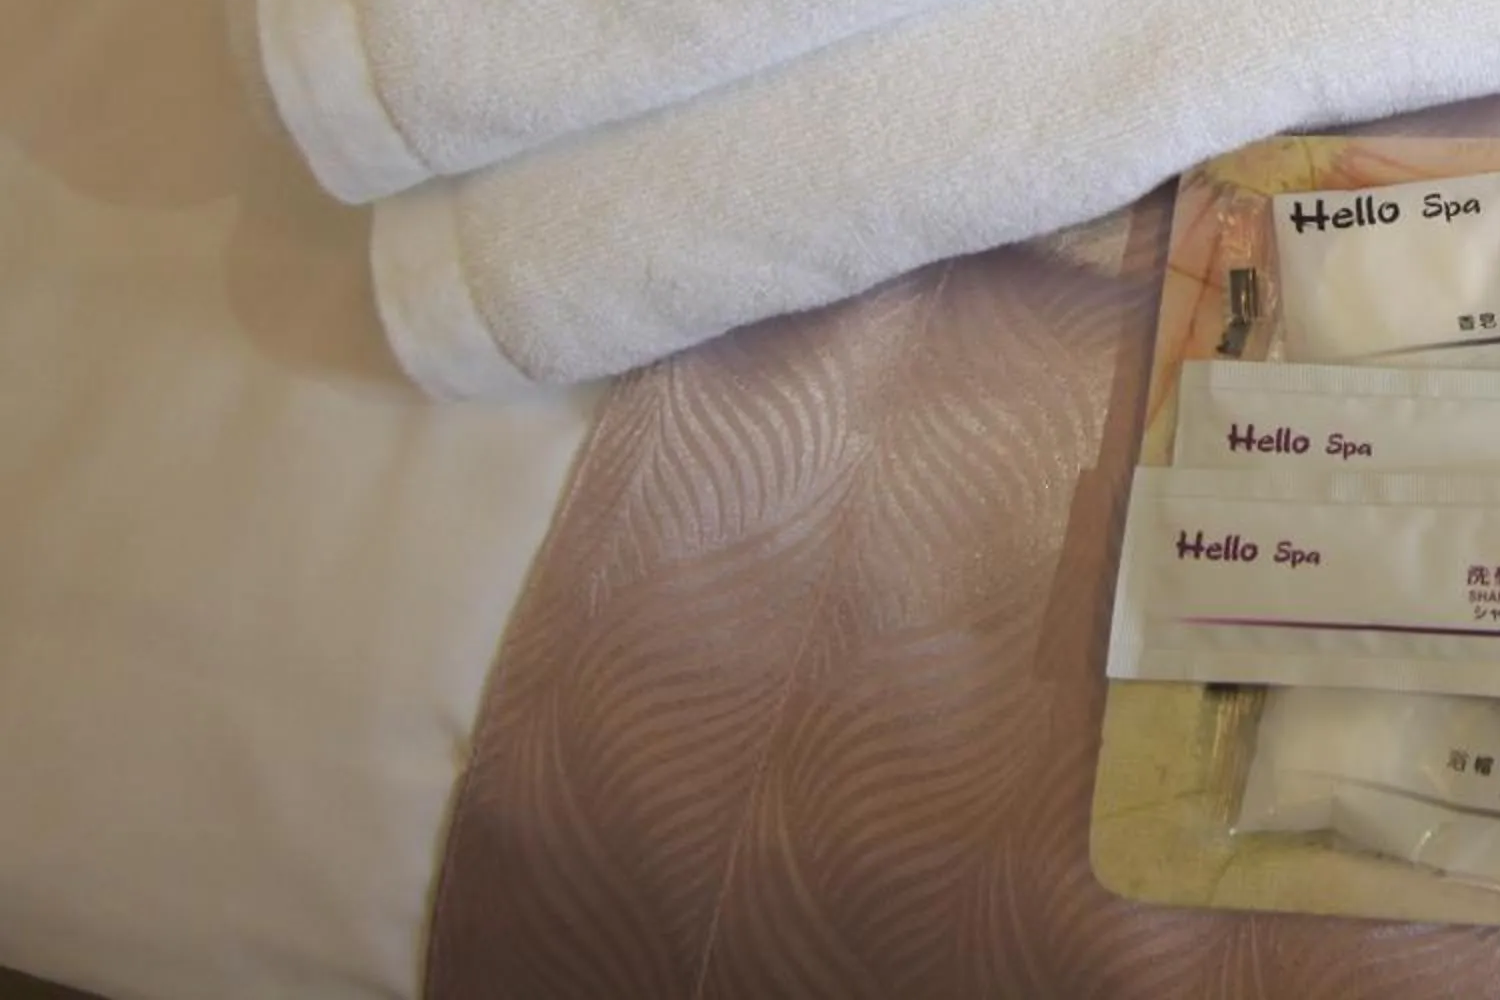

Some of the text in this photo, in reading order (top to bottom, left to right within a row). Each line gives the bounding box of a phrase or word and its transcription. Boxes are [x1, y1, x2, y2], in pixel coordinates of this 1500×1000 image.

[1290, 193, 1481, 234] Hello Spa
[1227, 423, 1372, 461] Hello Spa
[1176, 529, 1321, 568] Hello Spa
[1447, 749, 1495, 776] 浴帽
